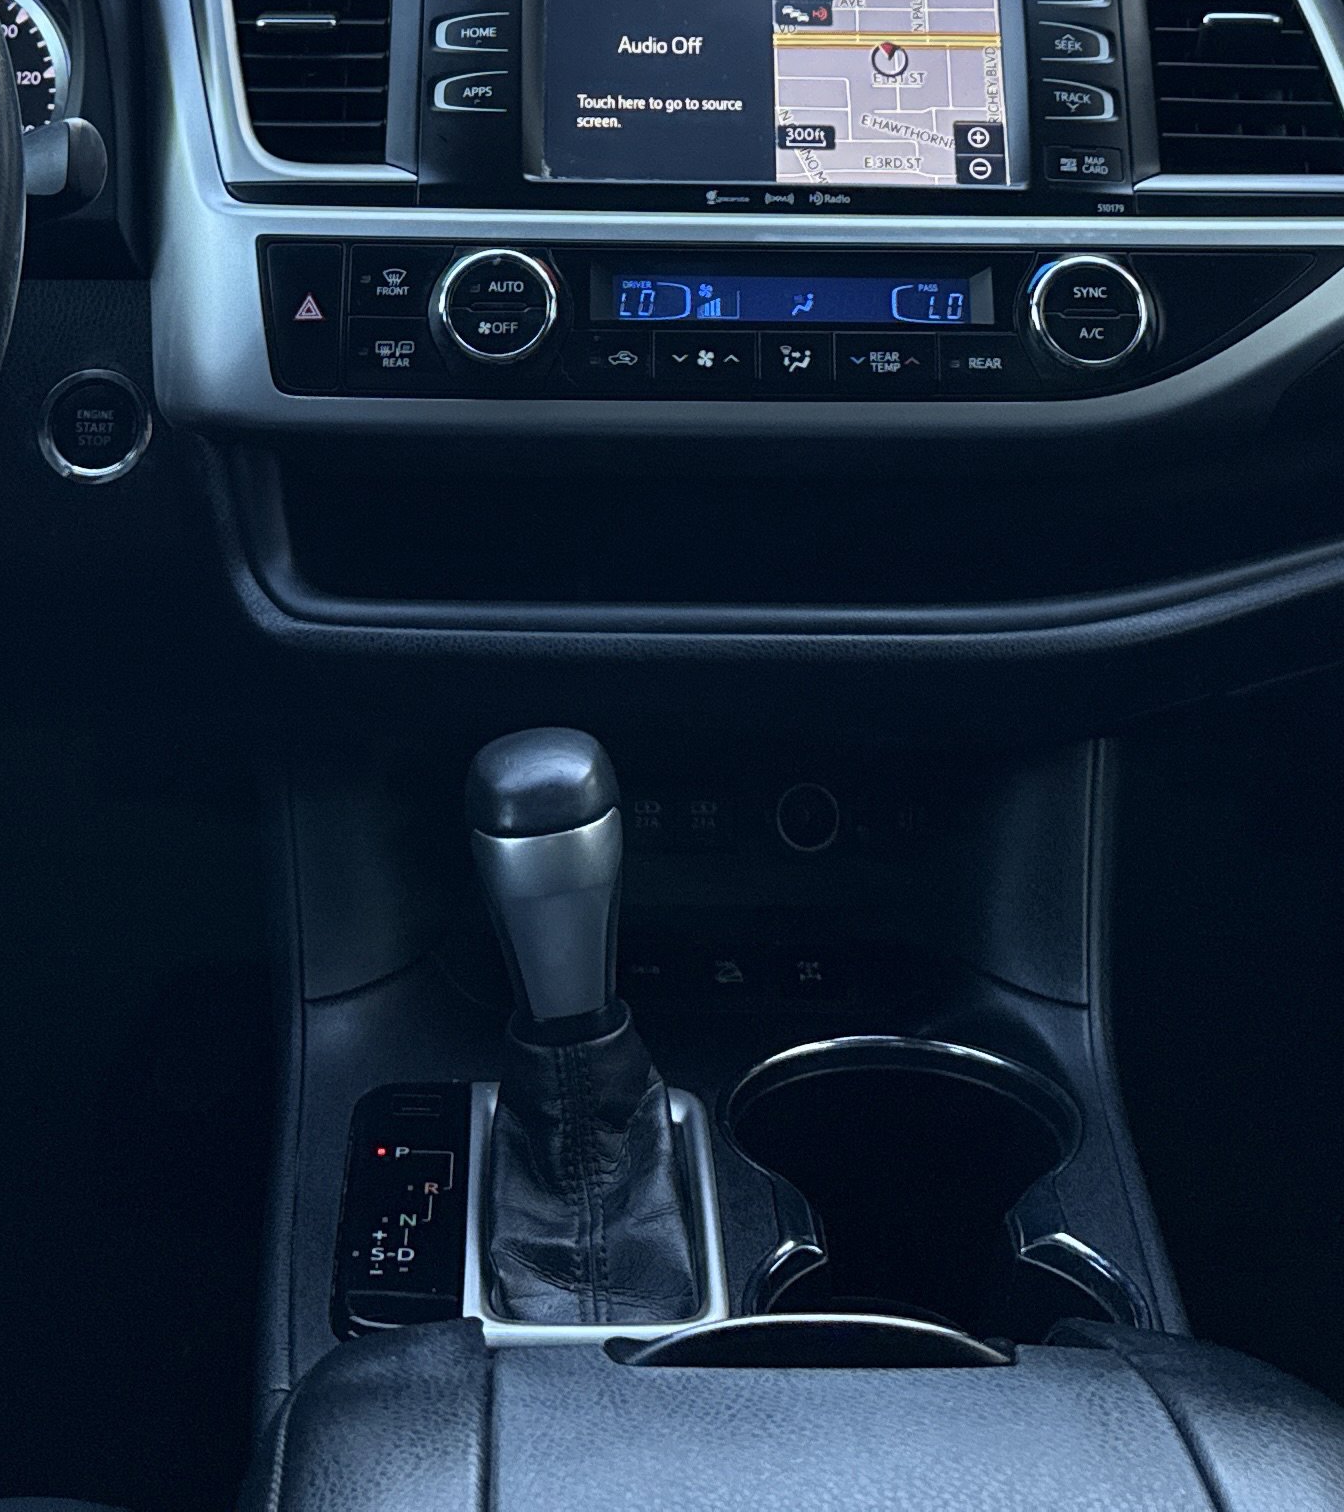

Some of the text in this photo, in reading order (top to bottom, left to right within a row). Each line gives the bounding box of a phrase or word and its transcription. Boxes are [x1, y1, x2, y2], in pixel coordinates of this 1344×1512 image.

[460, 27, 497, 38] HOME
[617, 35, 704, 55] Audio Off
[1054, 39, 1083, 51] SEEK
[985, 46, 999, 79] BLVD
[15, 70, 42, 86] 120
[873, 72, 882, 84] E
[909, 72, 926, 84] ST
[462, 86, 493, 98] APPS
[1053, 91, 1092, 105] TRACK
[576, 93, 743, 113] Touch here to go to source
[576, 116, 622, 128] screen.
[861, 114, 870, 126] E
[785, 127, 826, 141] 300ft
[864, 157, 923, 169] E 3RD ST
[1083, 155, 1106, 166] MAP
[1081, 164, 1109, 176] CARD
[823, 193, 851, 205] Radio
[376, 285, 410, 296] FRONT
[488, 281, 525, 293] AUTO
[621, 280, 652, 289] DRIVER
[917, 283, 938, 293] PASS
[1073, 286, 1108, 299] SYNC
[491, 322, 519, 335] OFF
[1079, 327, 1105, 340] A/C
[382, 357, 410, 368] REAR
[869, 351, 900, 362] REAR
[870, 362, 902, 373] TEMP
[968, 357, 1003, 369] REAR
[76, 409, 115, 420] ENGINE
[75, 421, 115, 433] START
[77, 435, 112, 447] STOP
[395, 1145, 410, 1158] P
[424, 1182, 439, 1194] R
[399, 1213, 417, 1227] N
